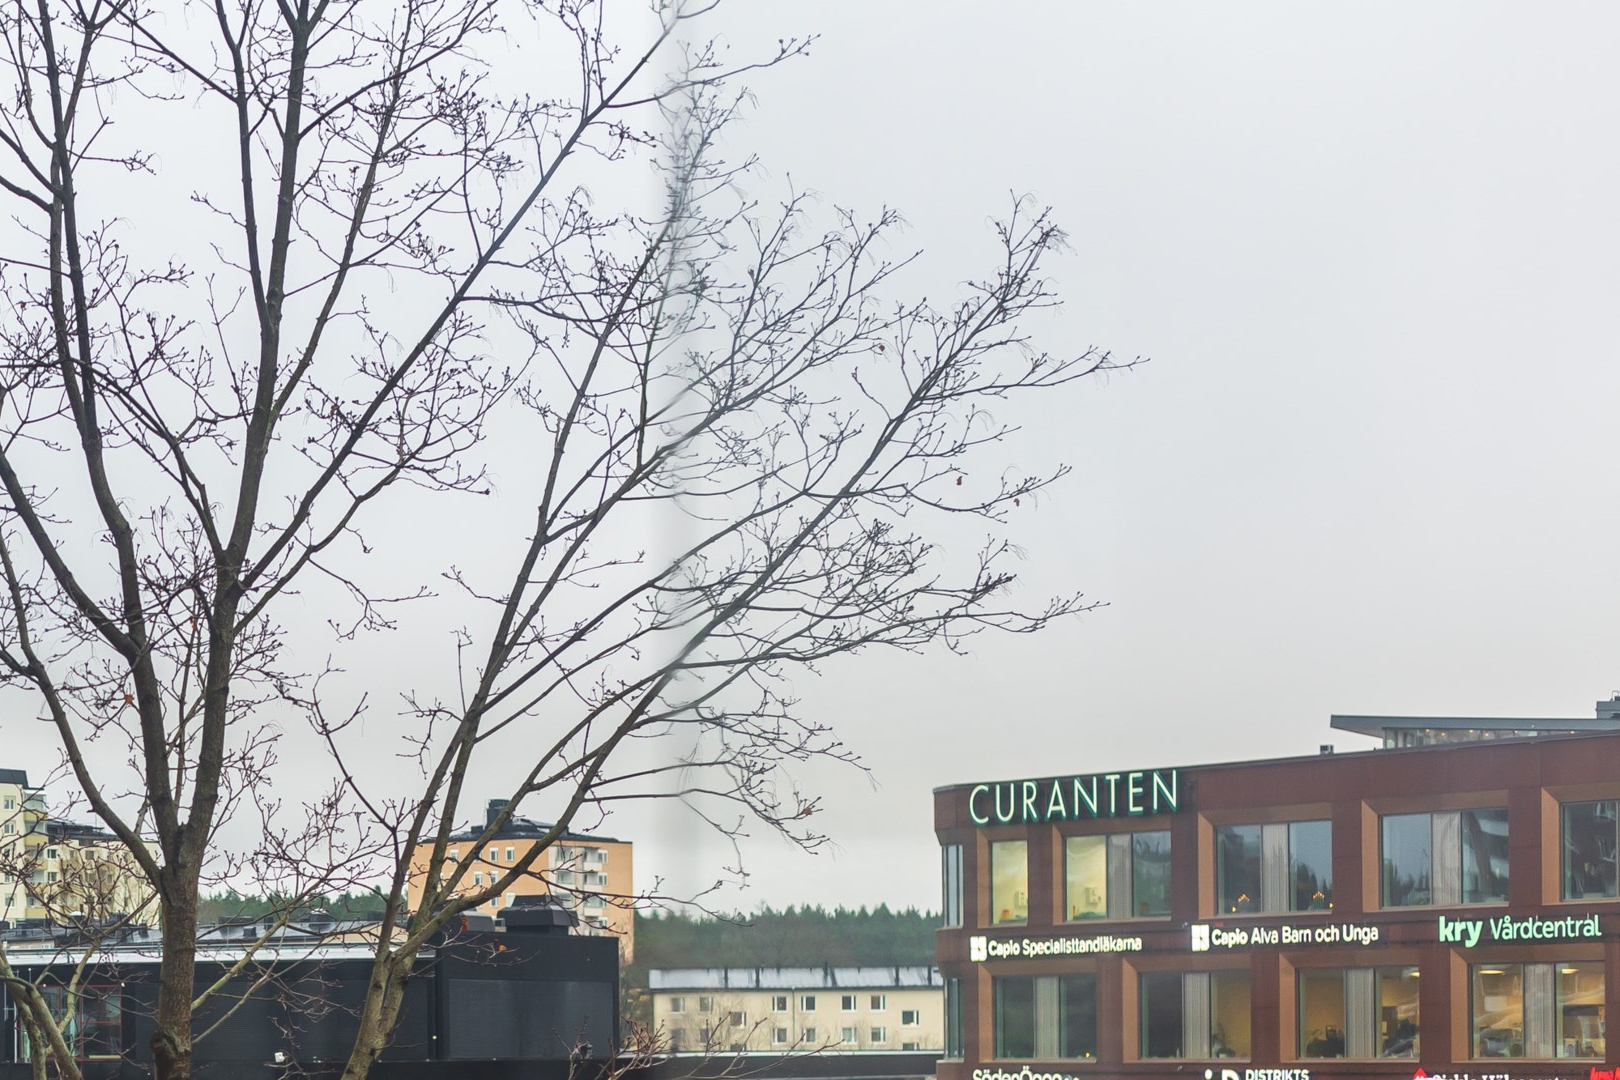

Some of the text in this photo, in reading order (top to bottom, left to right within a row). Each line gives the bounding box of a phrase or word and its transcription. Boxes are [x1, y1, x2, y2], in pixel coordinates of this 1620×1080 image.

[968, 769, 1179, 824] CURANTEN
[1212, 924, 1379, 948] Capio Alva Barn och Unga
[1439, 914, 1602, 947] kry Vårdcentral
[988, 936, 1142, 958] Capio Specialisttandläkarna
